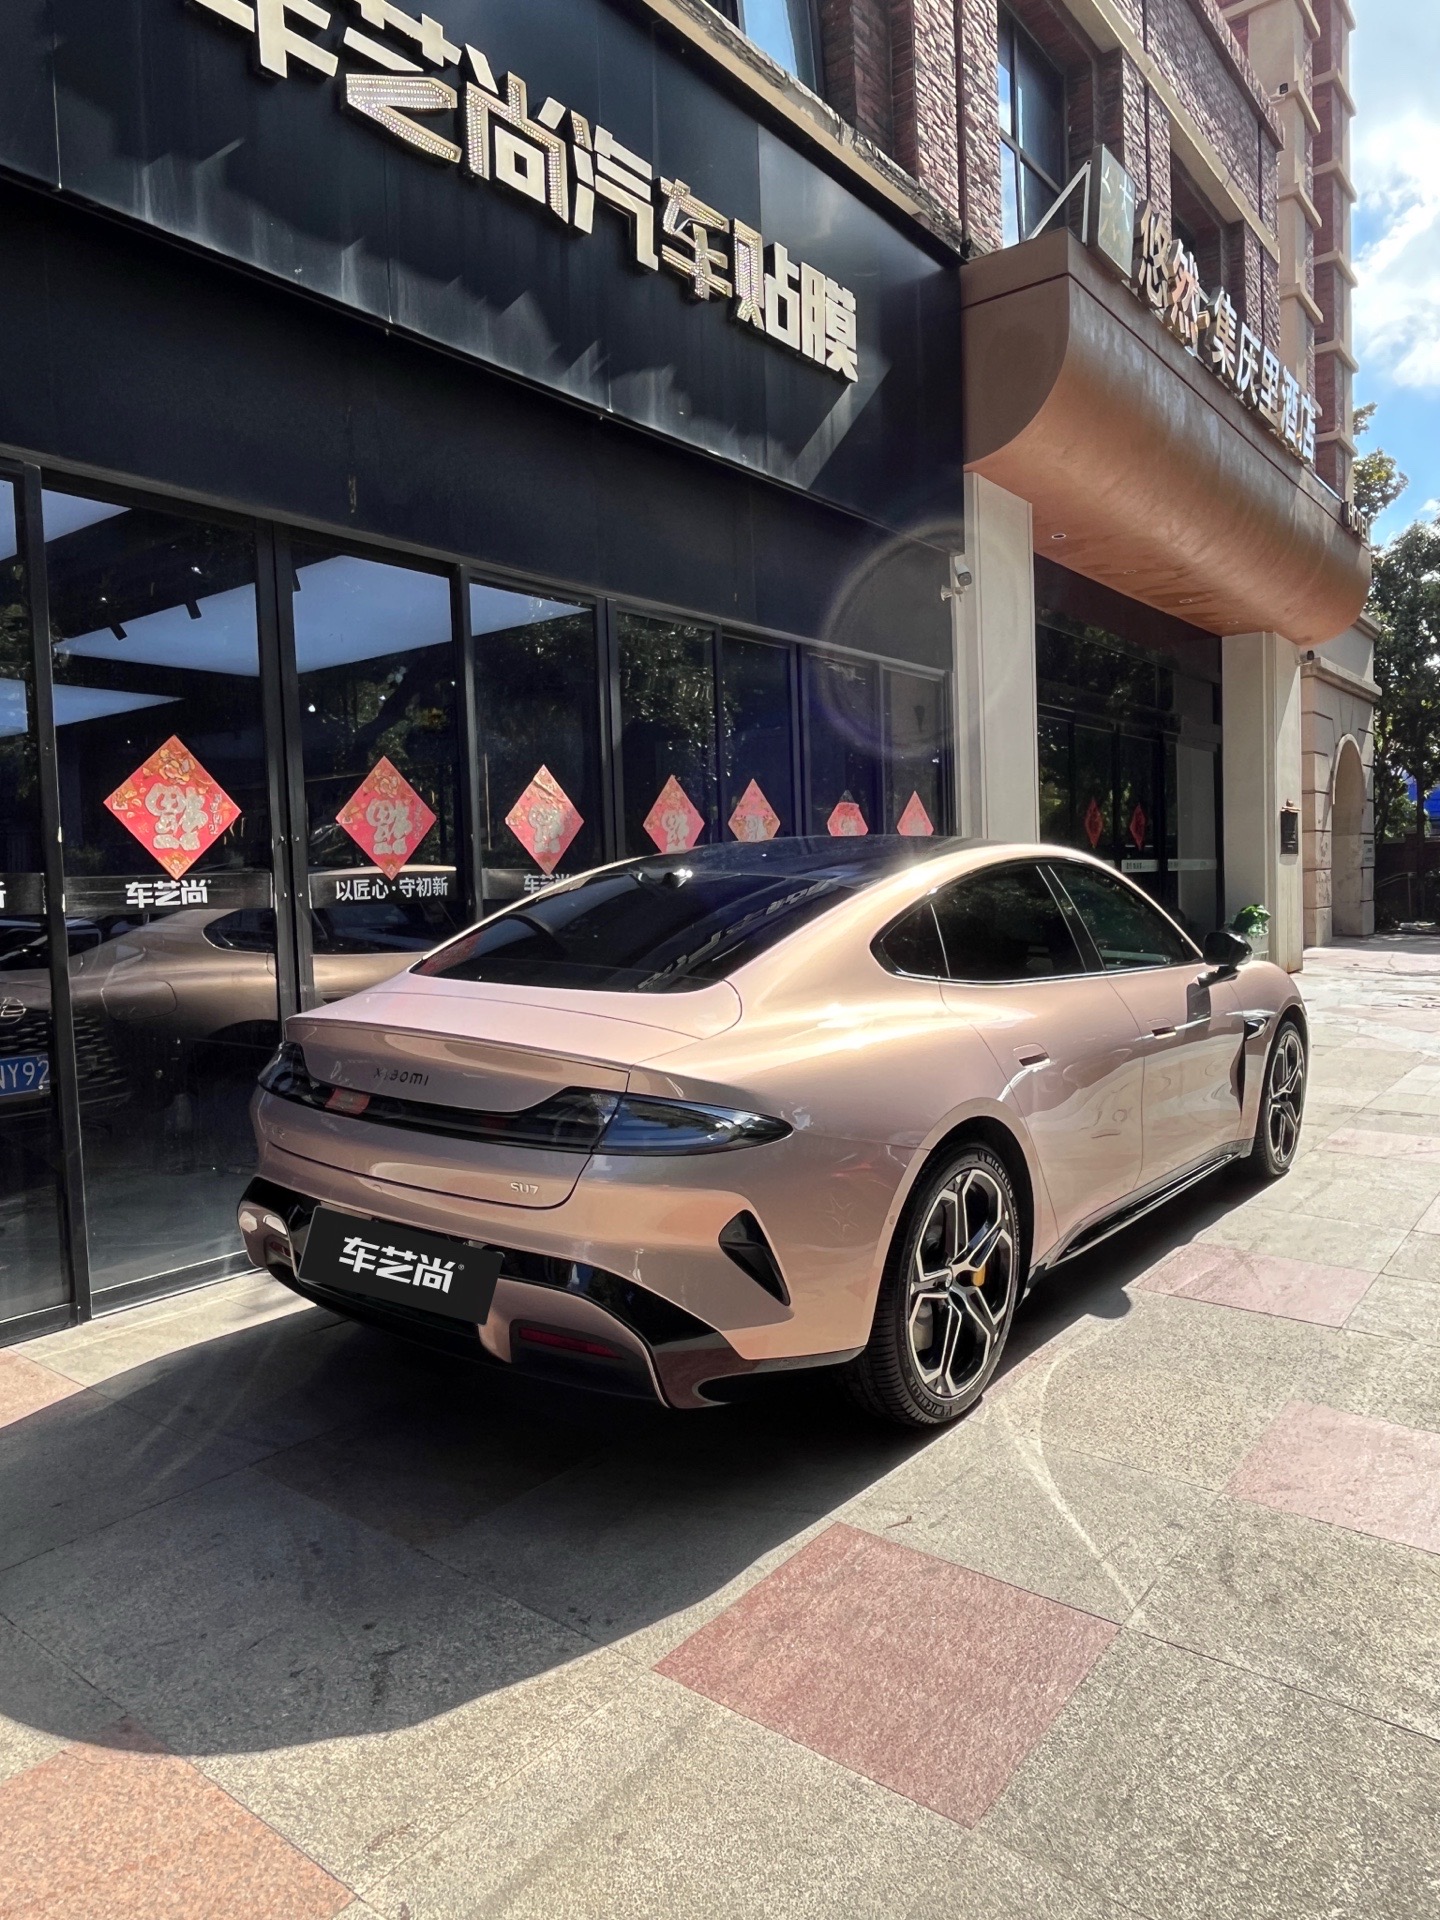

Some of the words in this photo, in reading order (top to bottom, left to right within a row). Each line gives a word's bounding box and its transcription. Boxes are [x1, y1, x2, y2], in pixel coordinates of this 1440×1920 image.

[125, 879, 208, 909] 车艺尚
[510, 1181, 539, 1195] SU7
[985, 1154, 1013, 1199] MICHELIN
